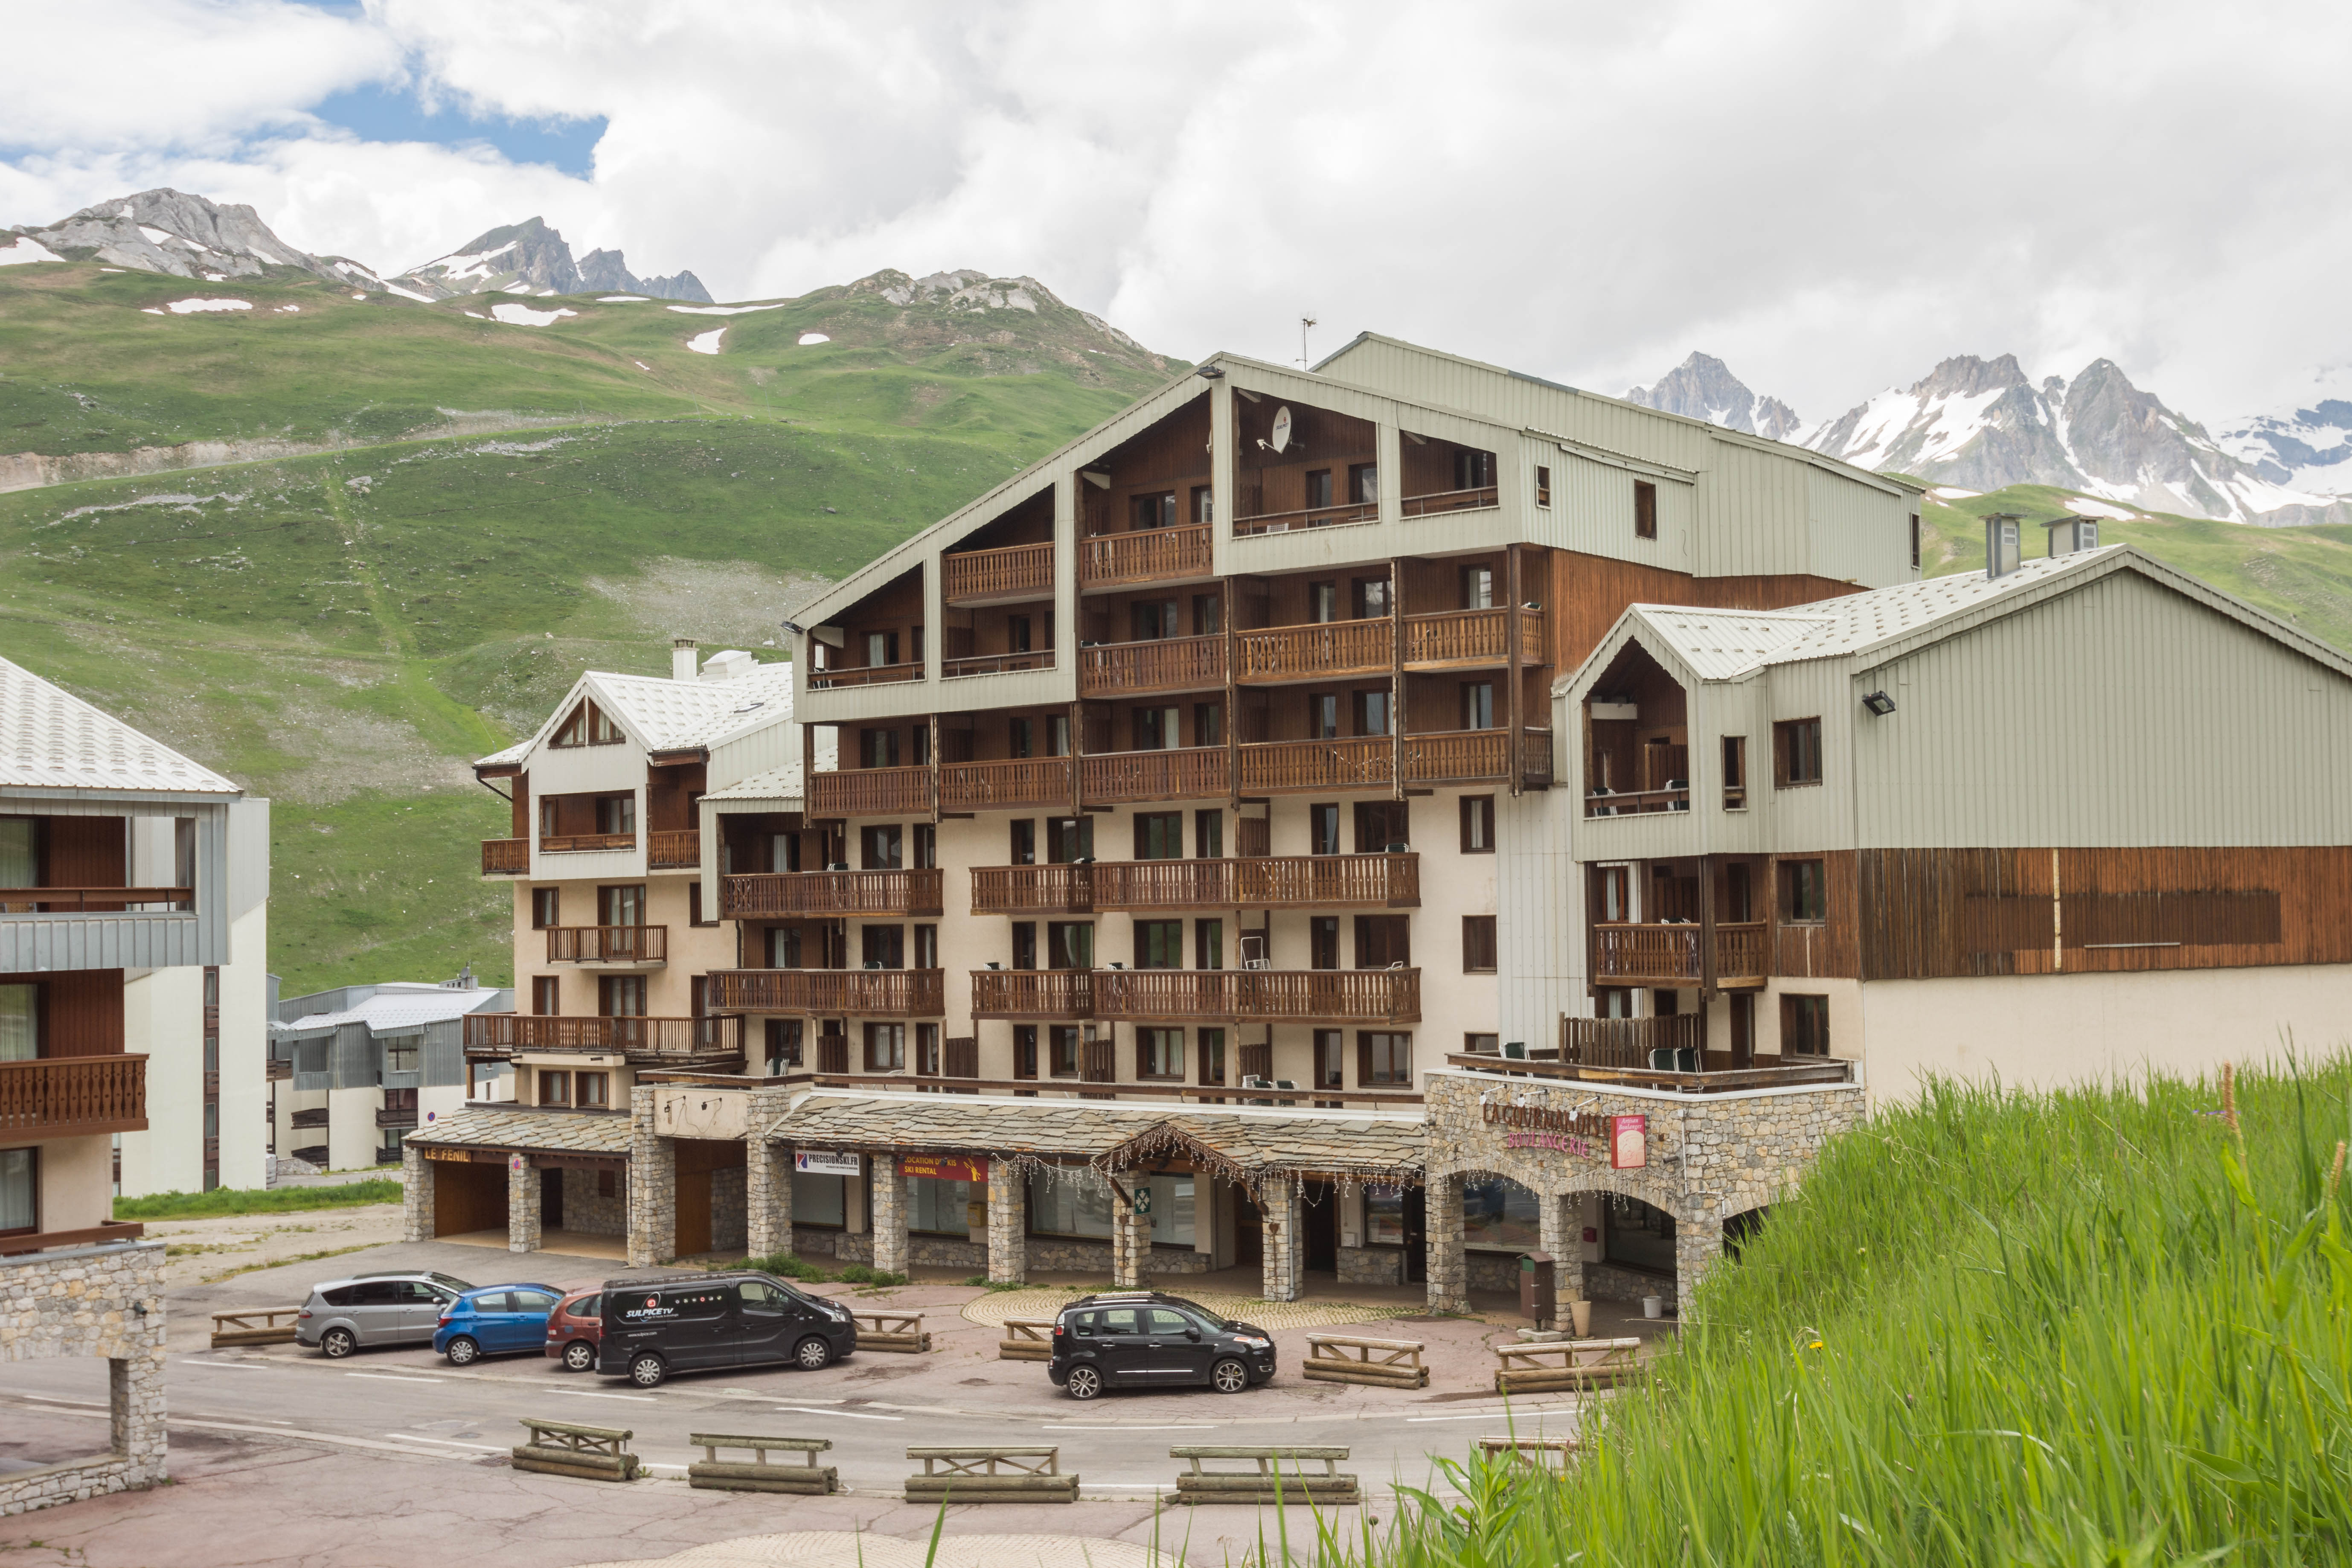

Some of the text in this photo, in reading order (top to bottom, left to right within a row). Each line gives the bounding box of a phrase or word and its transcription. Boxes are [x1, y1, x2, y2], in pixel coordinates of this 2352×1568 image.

[425, 1148, 469, 1162] LE FENIL
[809, 1154, 858, 1166] PRECISIONSKI.FR
[904, 1156, 933, 1165] OCATION
[915, 1167, 937, 1175] RENTAL
[626, 1308, 663, 1318] SULPICE
